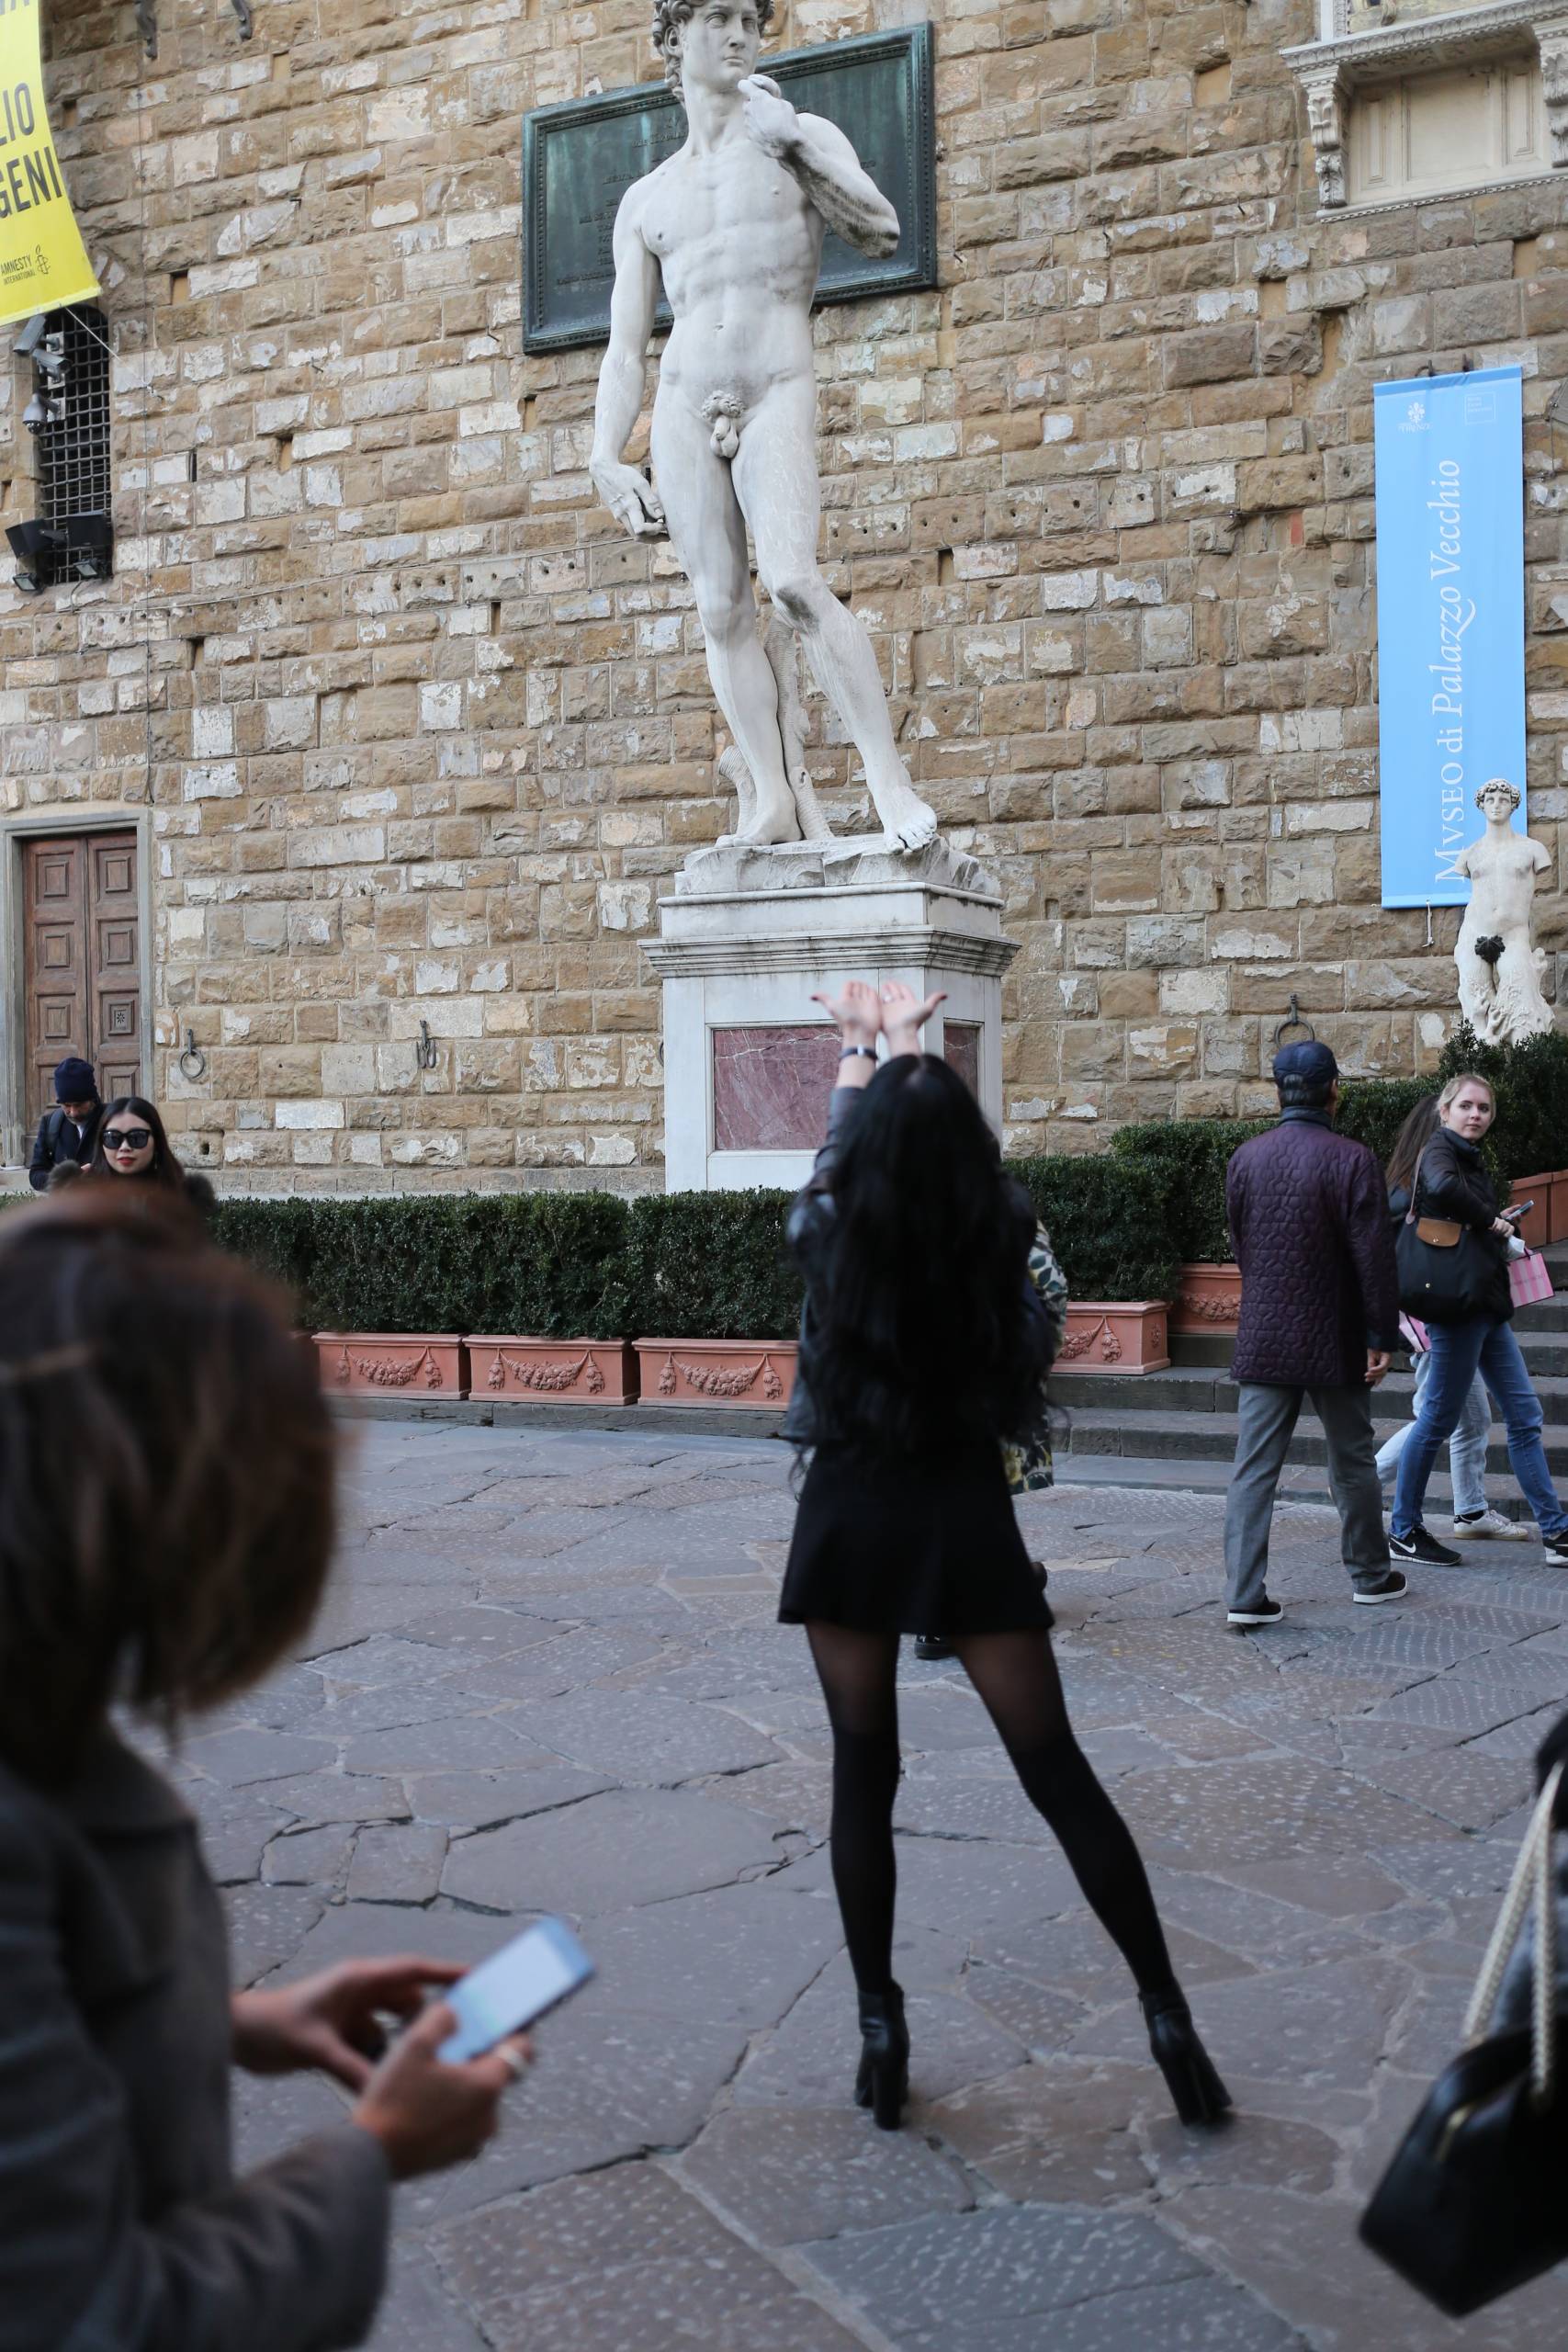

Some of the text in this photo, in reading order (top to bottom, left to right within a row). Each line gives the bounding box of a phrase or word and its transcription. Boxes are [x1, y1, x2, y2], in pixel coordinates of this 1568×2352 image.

[1, 254, 32, 276] AMNESTY
[1427, 458, 1461, 582] Vecchio
[1429, 585, 1476, 718] Palazzo
[1437, 726, 1463, 753] di
